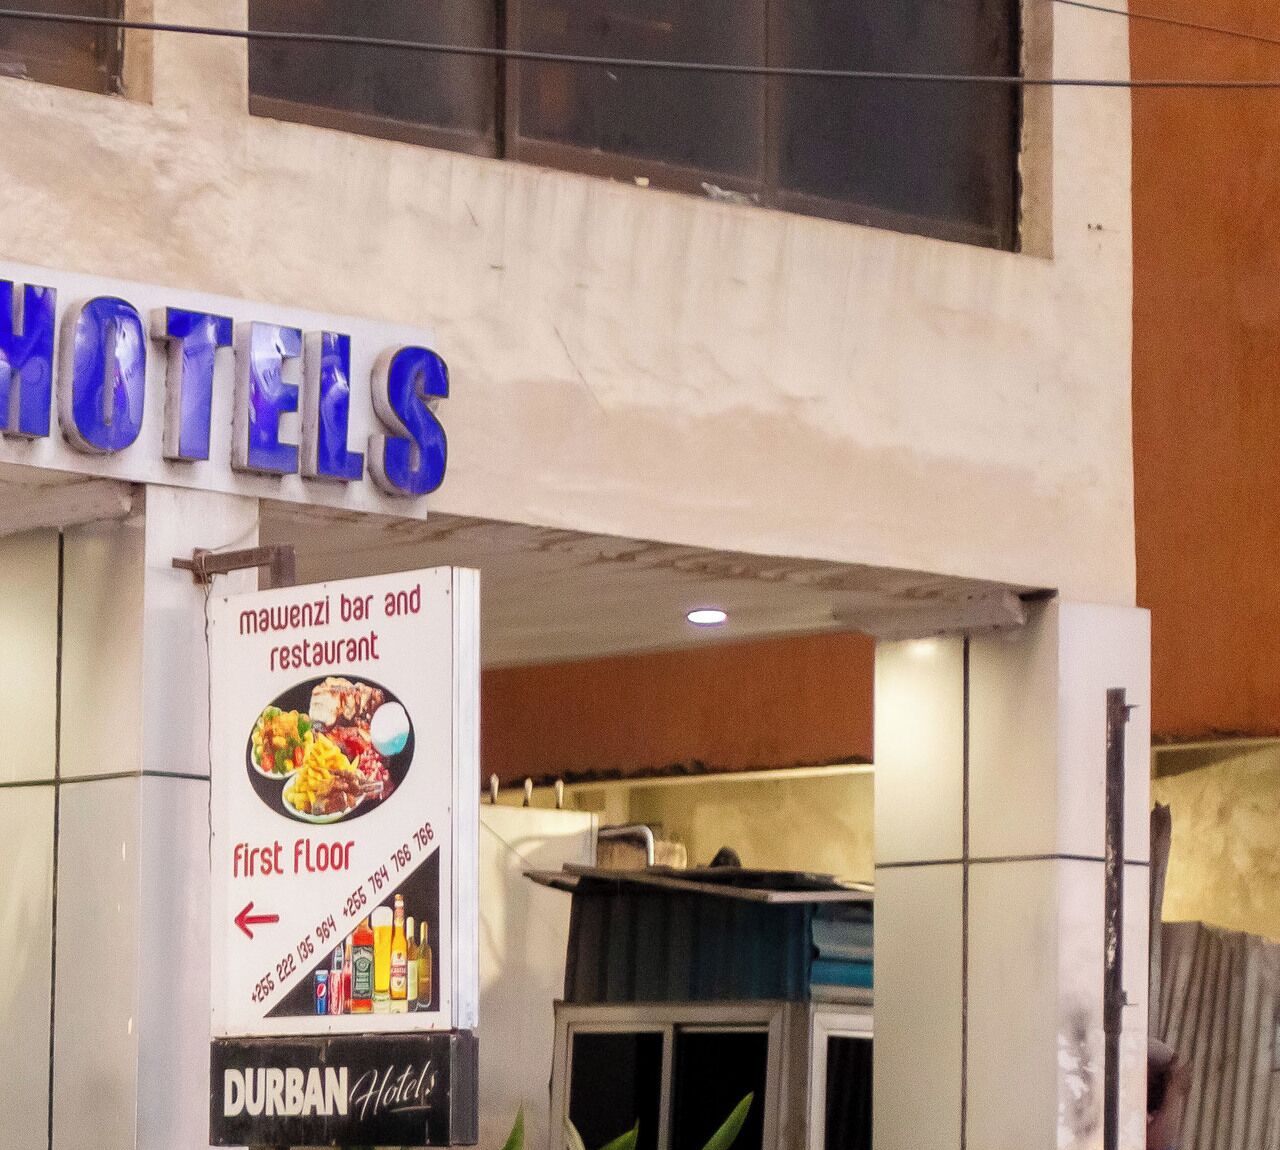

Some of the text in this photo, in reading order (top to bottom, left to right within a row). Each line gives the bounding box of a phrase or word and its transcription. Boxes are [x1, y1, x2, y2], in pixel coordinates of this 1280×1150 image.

[240, 584, 421, 635] mawenzi bar and
[270, 630, 380, 672] restaurant
[233, 838, 355, 878] first floor
[276, 953, 297, 983] 222
[296, 935, 315, 962] 135
[315, 914, 337, 945] 964
[368, 865, 390, 894] 764
[390, 844, 412, 872] 766
[413, 822, 434, 851] 766
[223, 1066, 348, 1118] DURBAN
